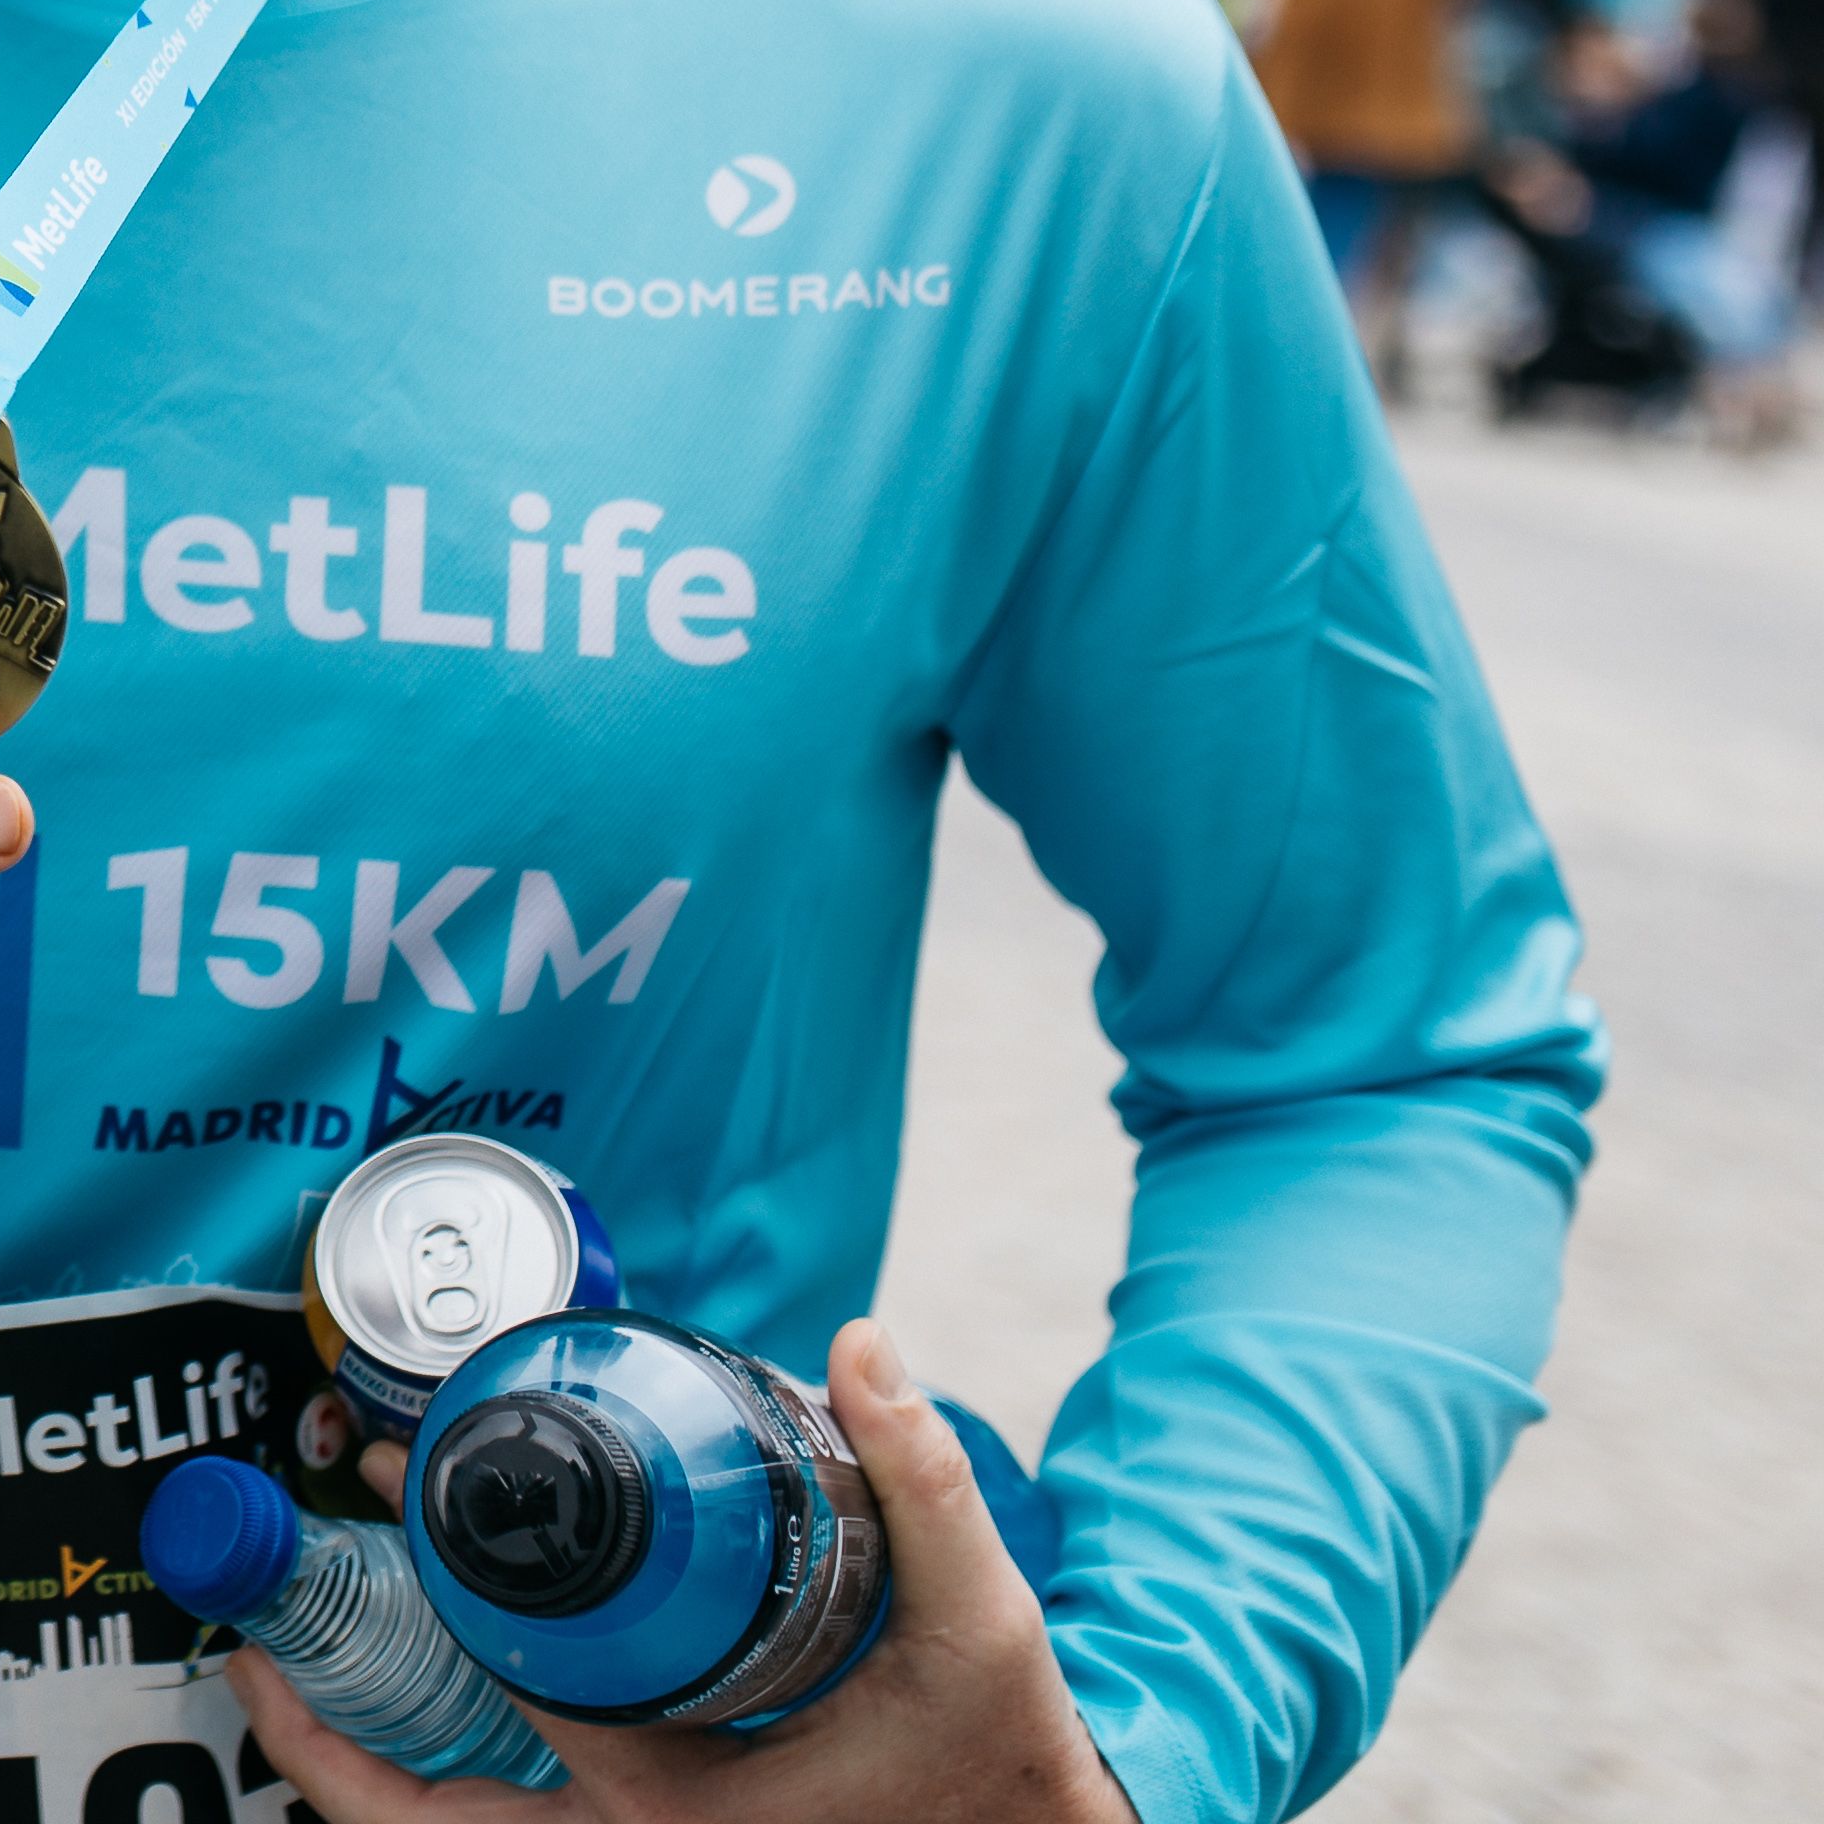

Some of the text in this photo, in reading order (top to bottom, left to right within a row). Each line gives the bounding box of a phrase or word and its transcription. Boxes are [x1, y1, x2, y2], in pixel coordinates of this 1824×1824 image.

[132, 29, 188, 107] EDICIÓN
[185, 1, 212, 33] 15K
[12, 156, 109, 270] MetLife
[547, 265, 950, 319] BOOMERANG
[105, 846, 692, 1015] 15KM
[94, 1101, 351, 1152] MADRID
[774, 1584, 794, 1596] 1
[787, 1547, 801, 1581] Litro
[663, 1640, 767, 1717] POWERADE
